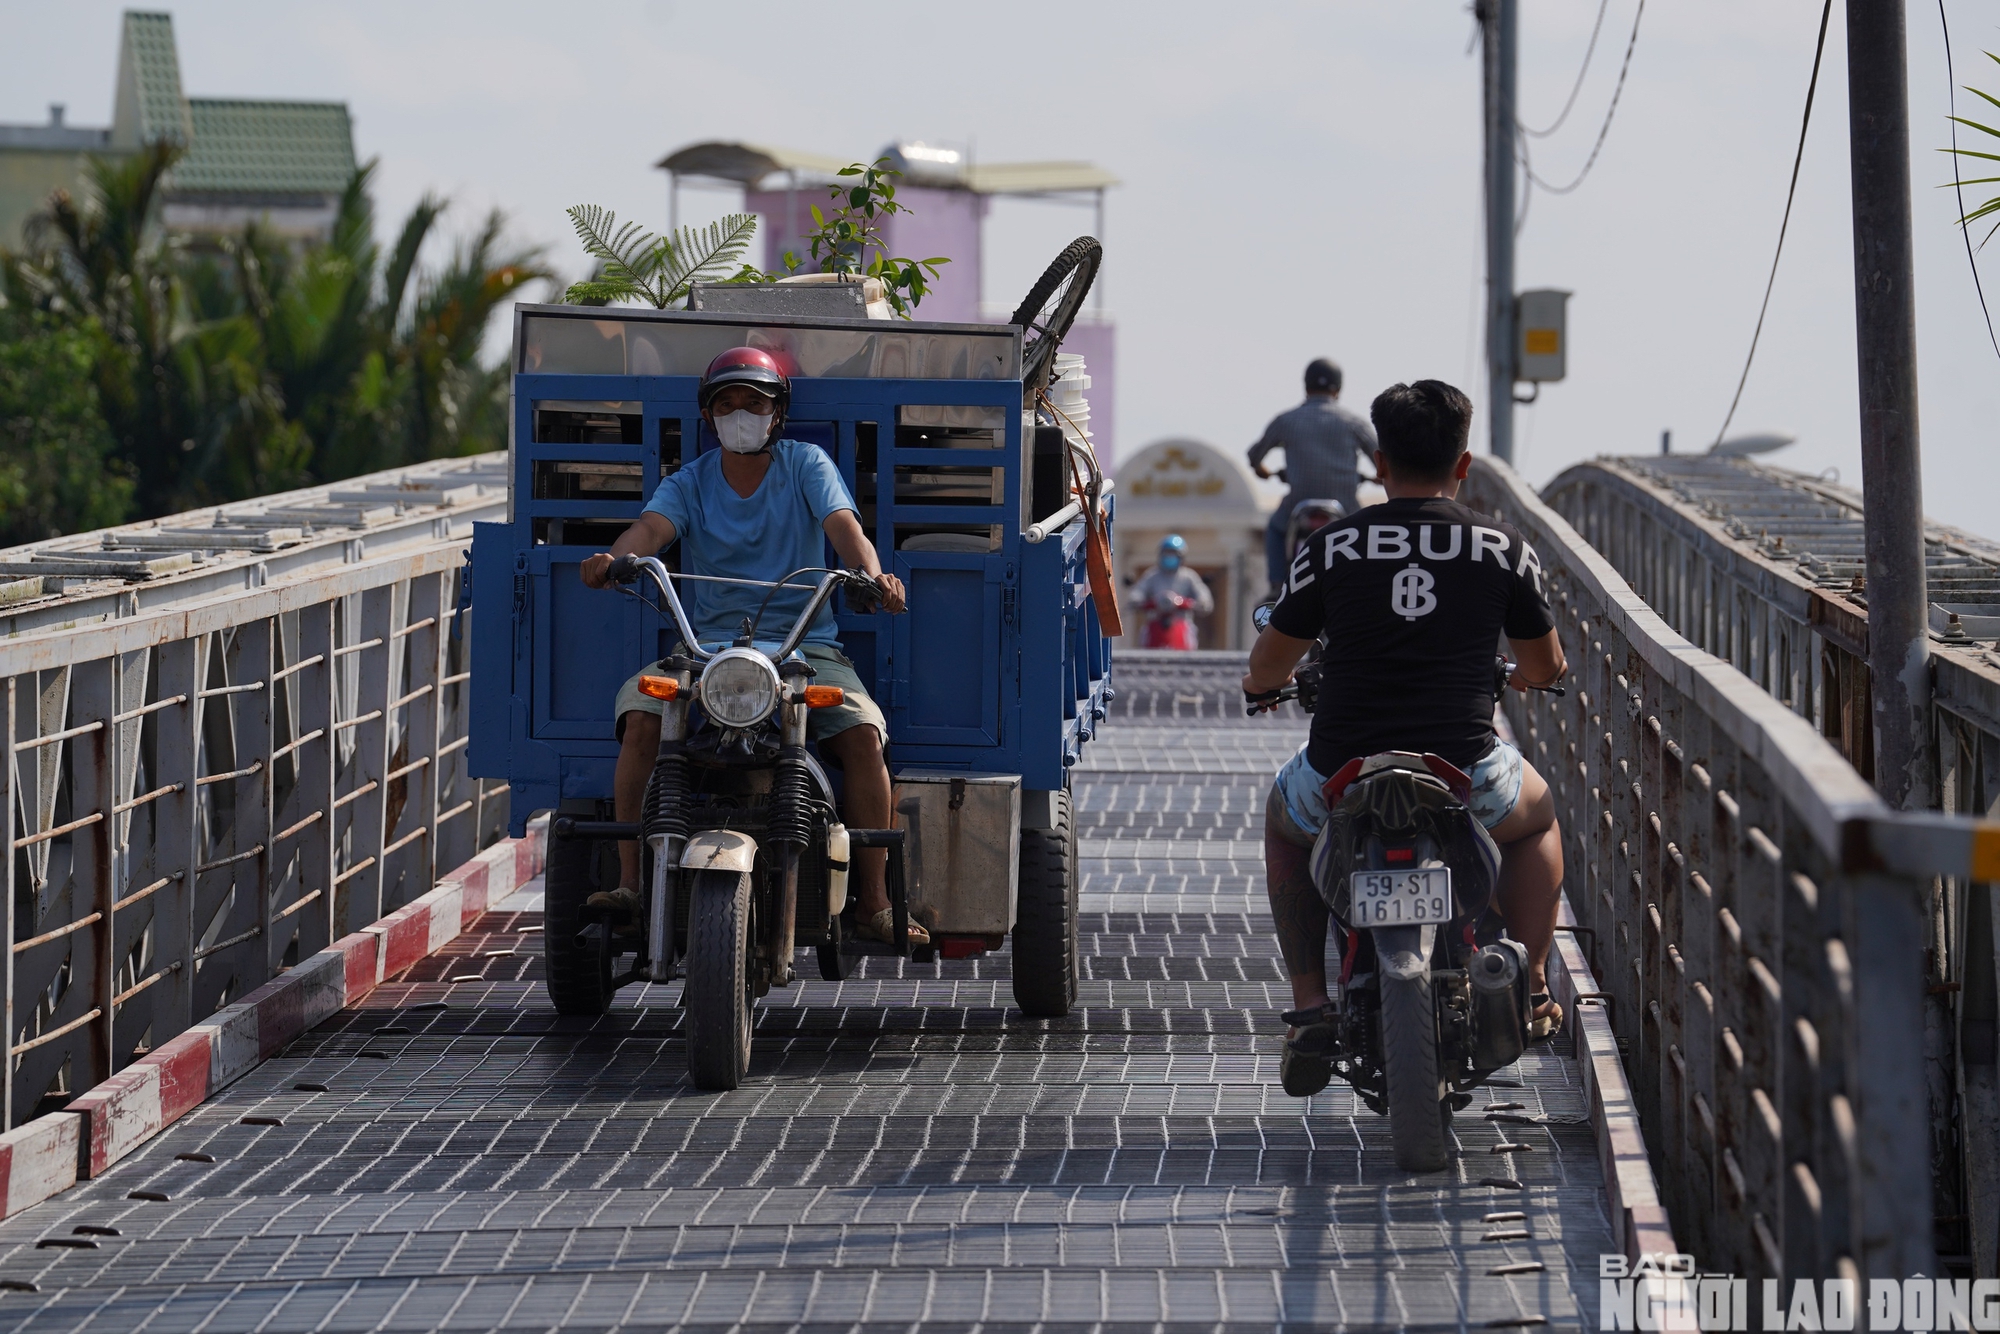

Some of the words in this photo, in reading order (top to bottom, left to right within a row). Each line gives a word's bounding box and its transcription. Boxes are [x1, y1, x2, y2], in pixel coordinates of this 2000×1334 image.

[1275, 525, 1550, 606] ERBURR
[1366, 873, 1431, 897] 59-S1
[1358, 897, 1443, 922] 161.69
